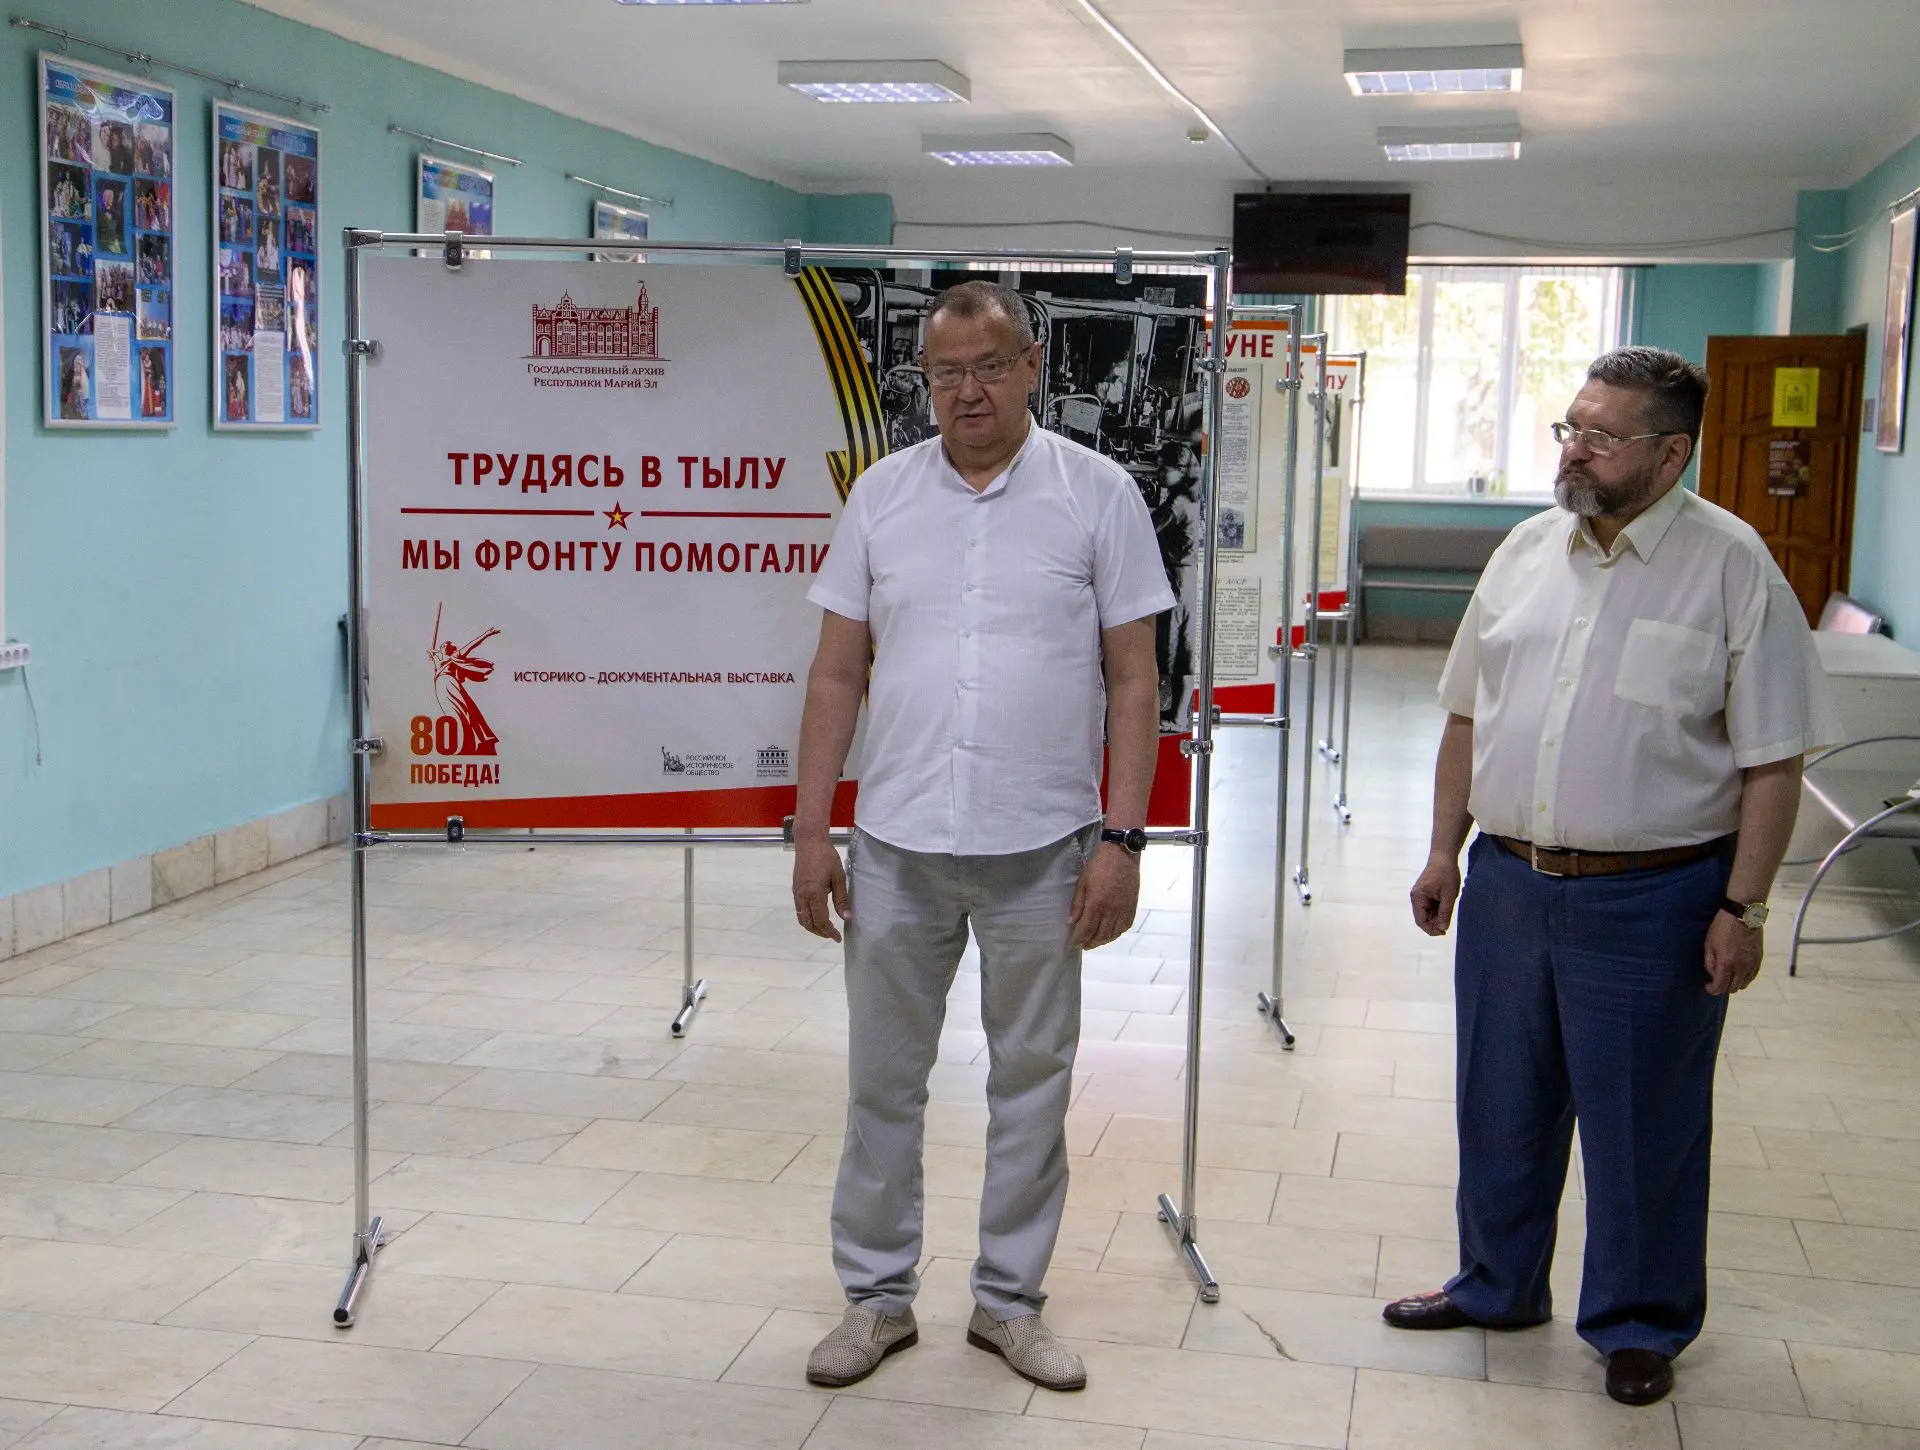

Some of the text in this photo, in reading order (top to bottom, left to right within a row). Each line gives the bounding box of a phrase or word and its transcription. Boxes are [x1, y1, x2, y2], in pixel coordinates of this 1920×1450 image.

[447, 452, 787, 494] ТРУДЯСЬ В ТЫЛУ
[402, 539, 831, 574] МЫ ФРОНТУ ПОМОГАЛИ
[727, 673, 796, 684] ВЫСТАВКА
[411, 715, 458, 756] 80
[685, 754, 727, 762] РОССИЙСКОЕ
[410, 764, 500, 788] ПОБЕДА!
